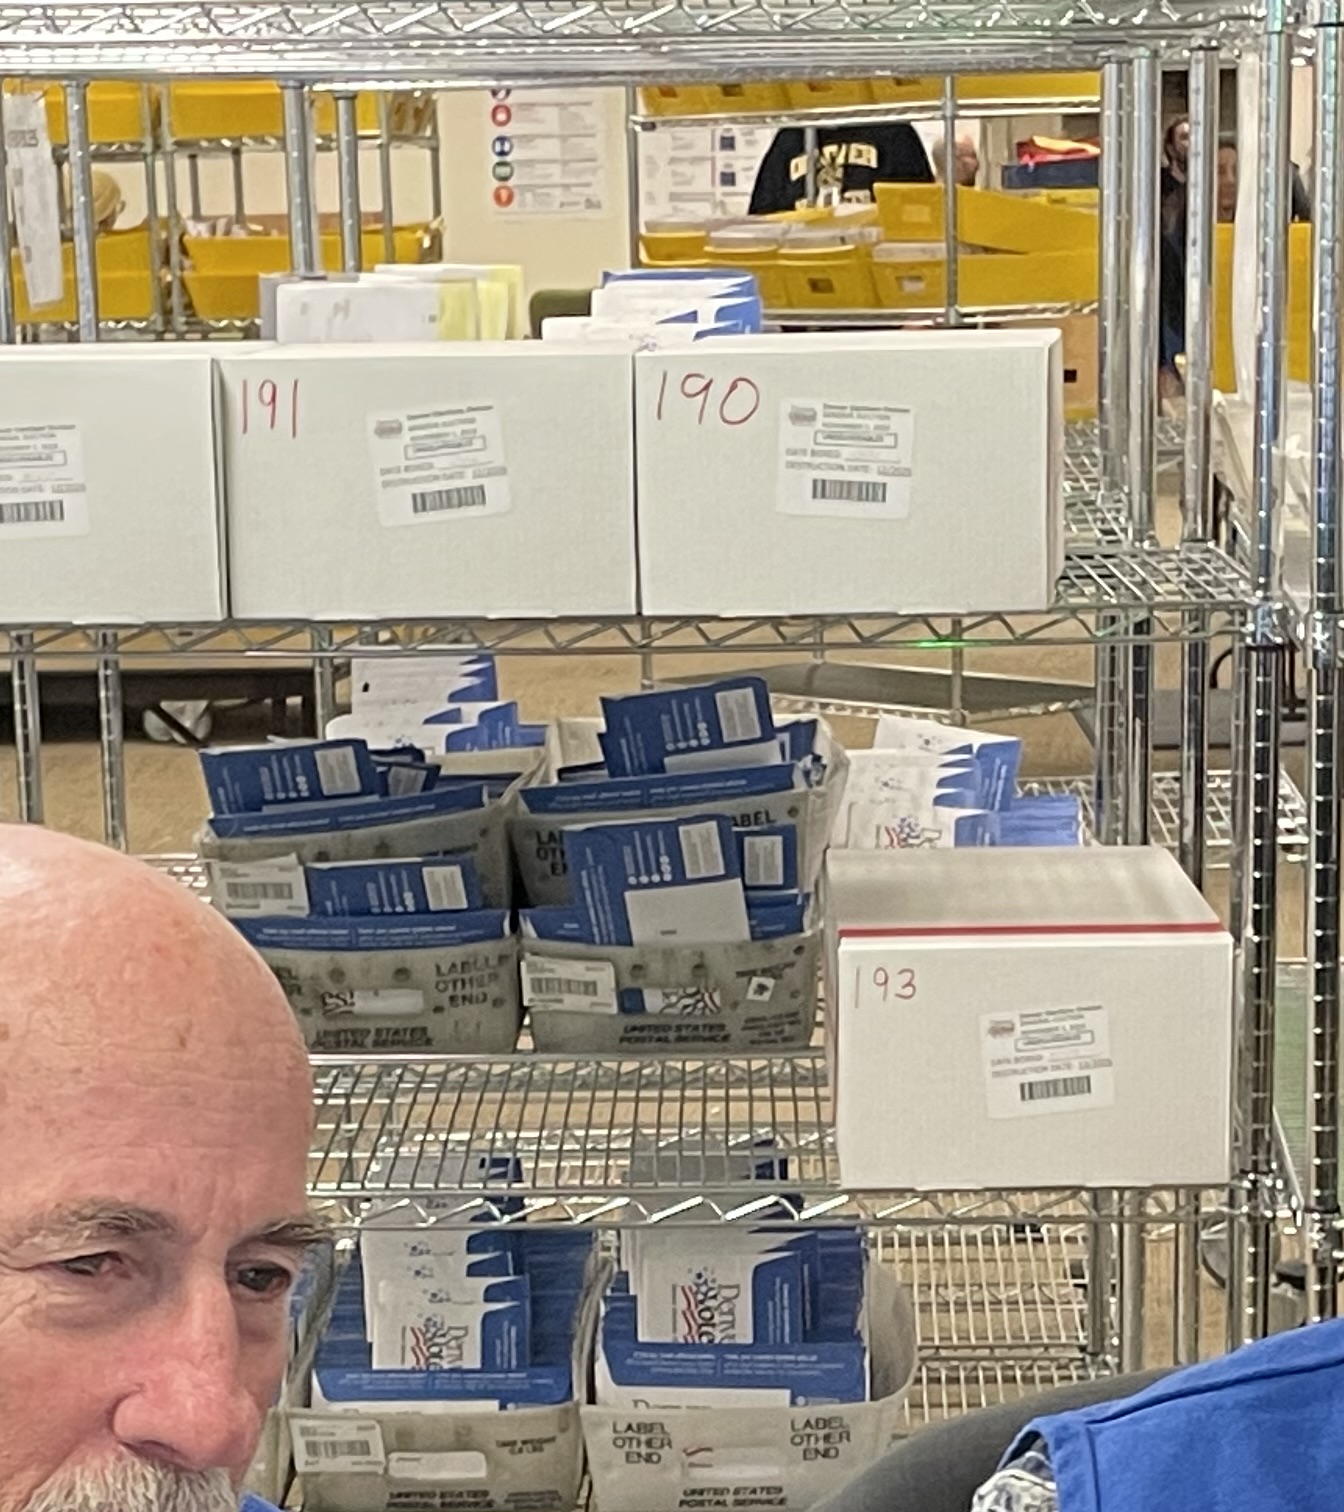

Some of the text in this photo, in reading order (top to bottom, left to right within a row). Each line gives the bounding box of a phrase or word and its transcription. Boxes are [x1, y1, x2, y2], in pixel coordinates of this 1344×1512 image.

[657, 370, 760, 427] 190
[241, 378, 300, 438] 191
[732, 808, 777, 827] ABEL
[853, 966, 918, 1009] 193
[612, 1421, 671, 1435] LABEL
[791, 1416, 850, 1431] LABEL
[612, 1436, 673, 1450] OTHER
[790, 1431, 852, 1447] OTHER
[624, 1452, 662, 1465] END
[802, 1446, 840, 1461] END
[682, 1485, 784, 1497] UNITED STATES
[678, 1497, 788, 1508] POSTAL SERVICE
